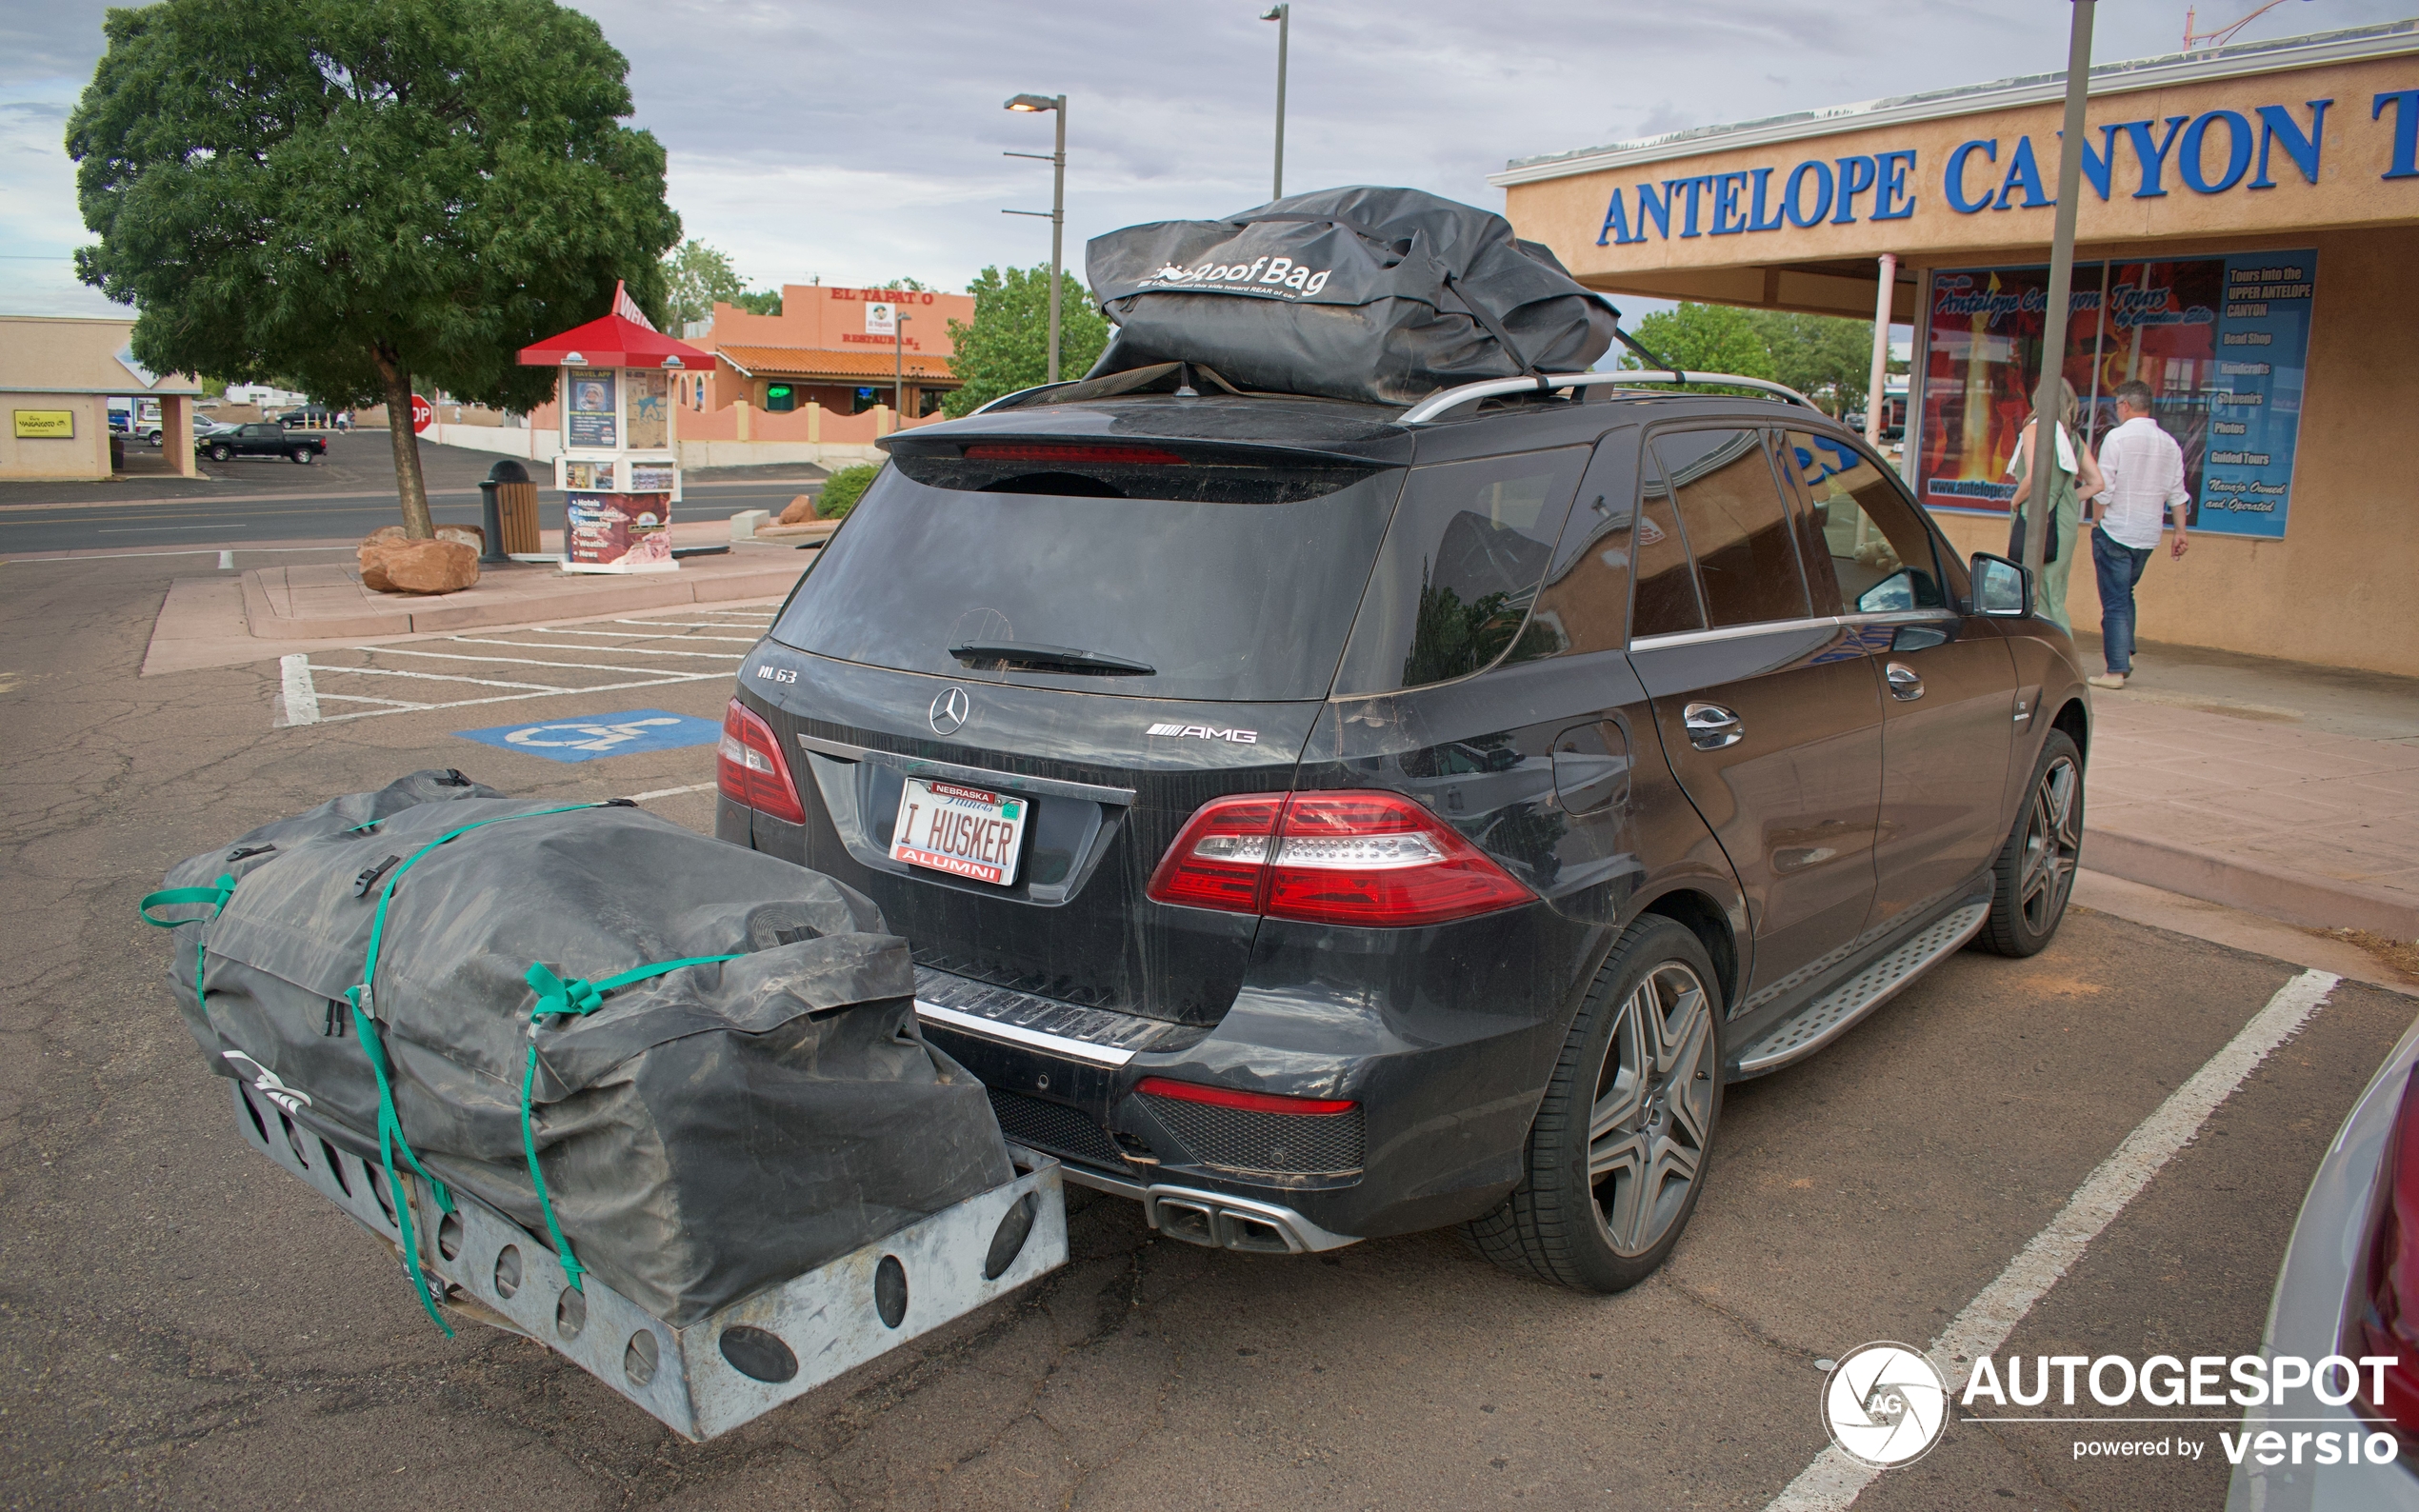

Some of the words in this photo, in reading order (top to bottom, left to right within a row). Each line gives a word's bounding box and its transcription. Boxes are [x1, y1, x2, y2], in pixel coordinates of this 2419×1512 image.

[1595, 149, 1917, 246] ANTELOPE
[1944, 97, 2334, 214] CANYON
[2230, 269, 2260, 283] Tours
[2261, 268, 2282, 282] into
[2283, 266, 2302, 280] the
[830, 288, 856, 300] EL
[1225, 284, 1249, 292] toward
[1249, 286, 1272, 295] REAR
[1283, 291, 1296, 300] car
[2229, 286, 2261, 300] UPPER
[2261, 284, 2312, 298] ANTELOPE
[1935, 287, 2019, 328] Antelope
[2021, 288, 2102, 323] Cayon
[2109, 284, 2170, 310] Tours
[2227, 303, 2268, 318] CANYON
[2113, 310, 2129, 328] by
[2223, 333, 2247, 345] Bead
[2248, 332, 2271, 345] Shop
[2220, 363, 2270, 375] Handcrafts
[2217, 392, 2263, 405] Souvenirs
[2214, 422, 2246, 434] Photos
[2210, 450, 2243, 465] Guided
[2243, 452, 2270, 466] Tours
[2209, 479, 2247, 494] Navajo
[2249, 481, 2287, 494] Owned
[578, 499, 601, 507] Hotels
[2205, 498, 2226, 508] and
[2228, 497, 2275, 512] Operated
[577, 509, 619, 518] Restaurants
[578, 520, 612, 529] Shopping
[580, 540, 609, 548] Weather
[1179, 726, 1258, 744] AMG
[936, 785, 990, 802] NEBRASKA
[901, 803, 919, 845] I
[927, 807, 1014, 865] HUSKER
[902, 848, 996, 880] ALUMNI
